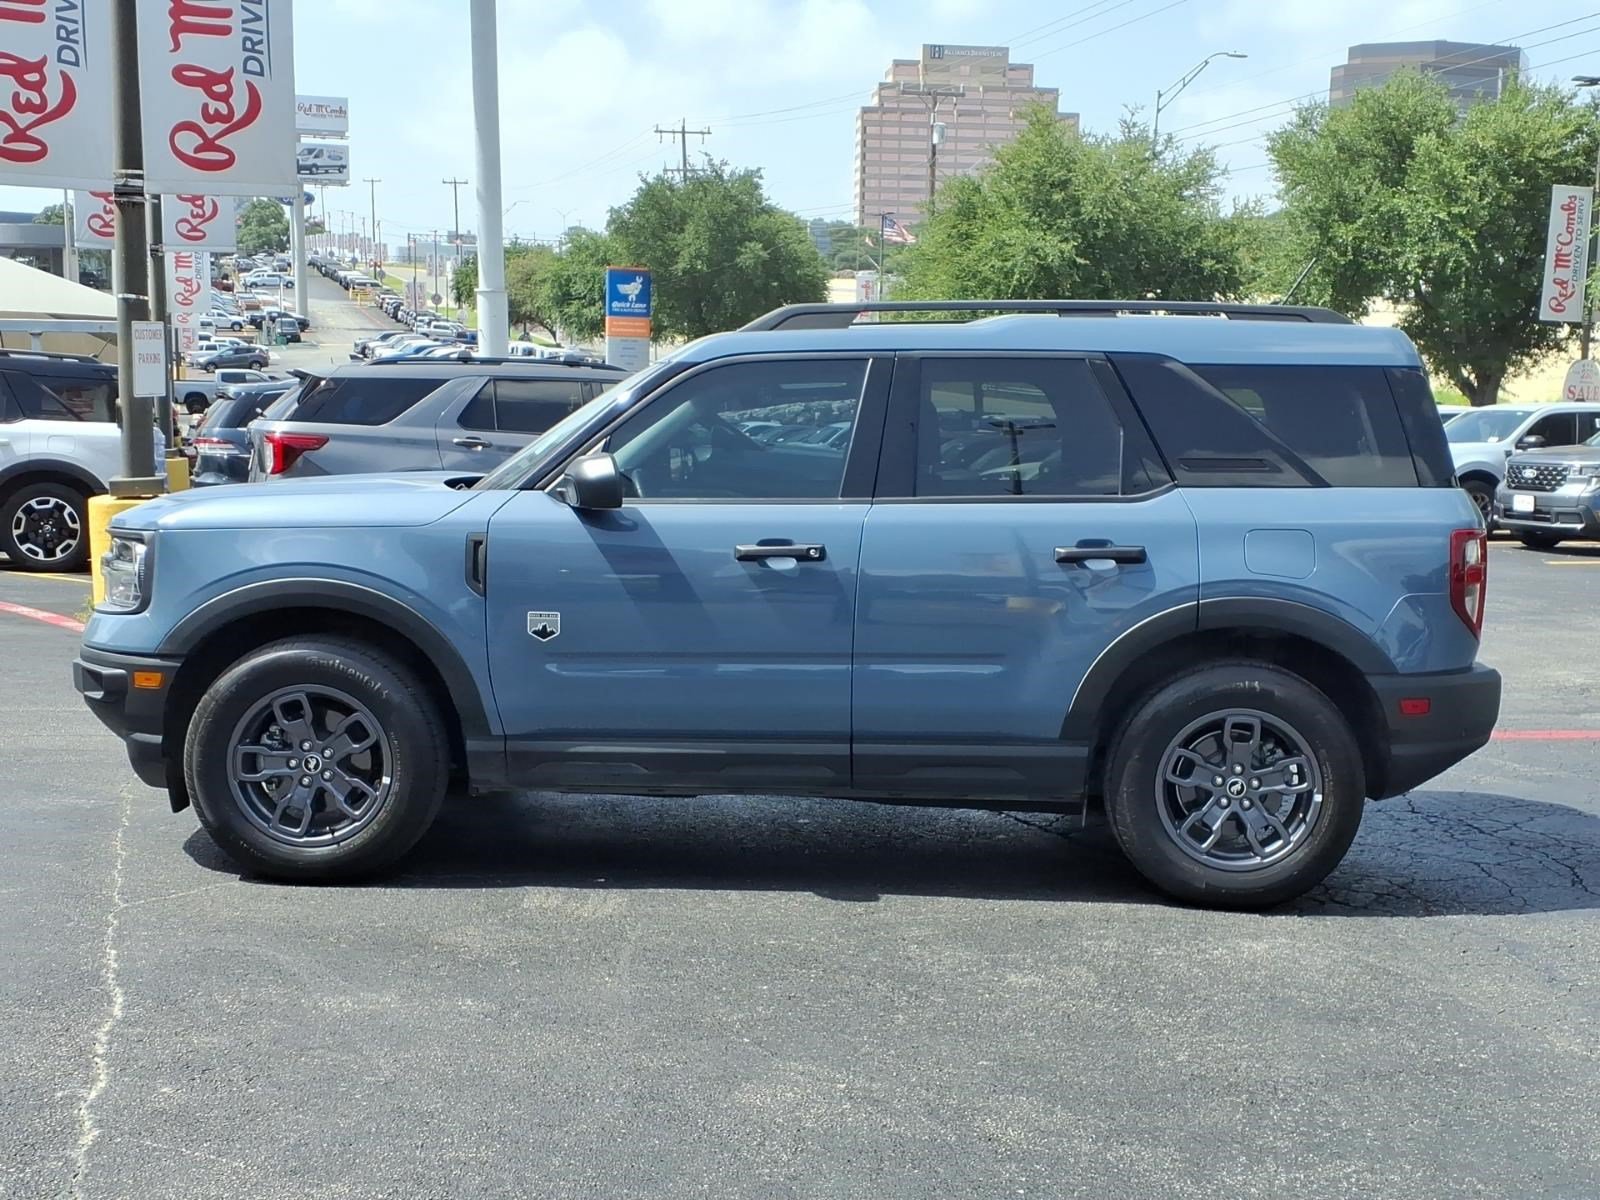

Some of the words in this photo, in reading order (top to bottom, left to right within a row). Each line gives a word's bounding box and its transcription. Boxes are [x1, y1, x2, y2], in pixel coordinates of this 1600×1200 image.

[168, 63, 262, 172] Red
[1577, 195, 1586, 224] SERVE
[1575, 228, 1583, 244] TO
[1572, 245, 1583, 282] DRIVEN
[174, 276, 202, 307] Red
[1548, 277, 1576, 313] Red
